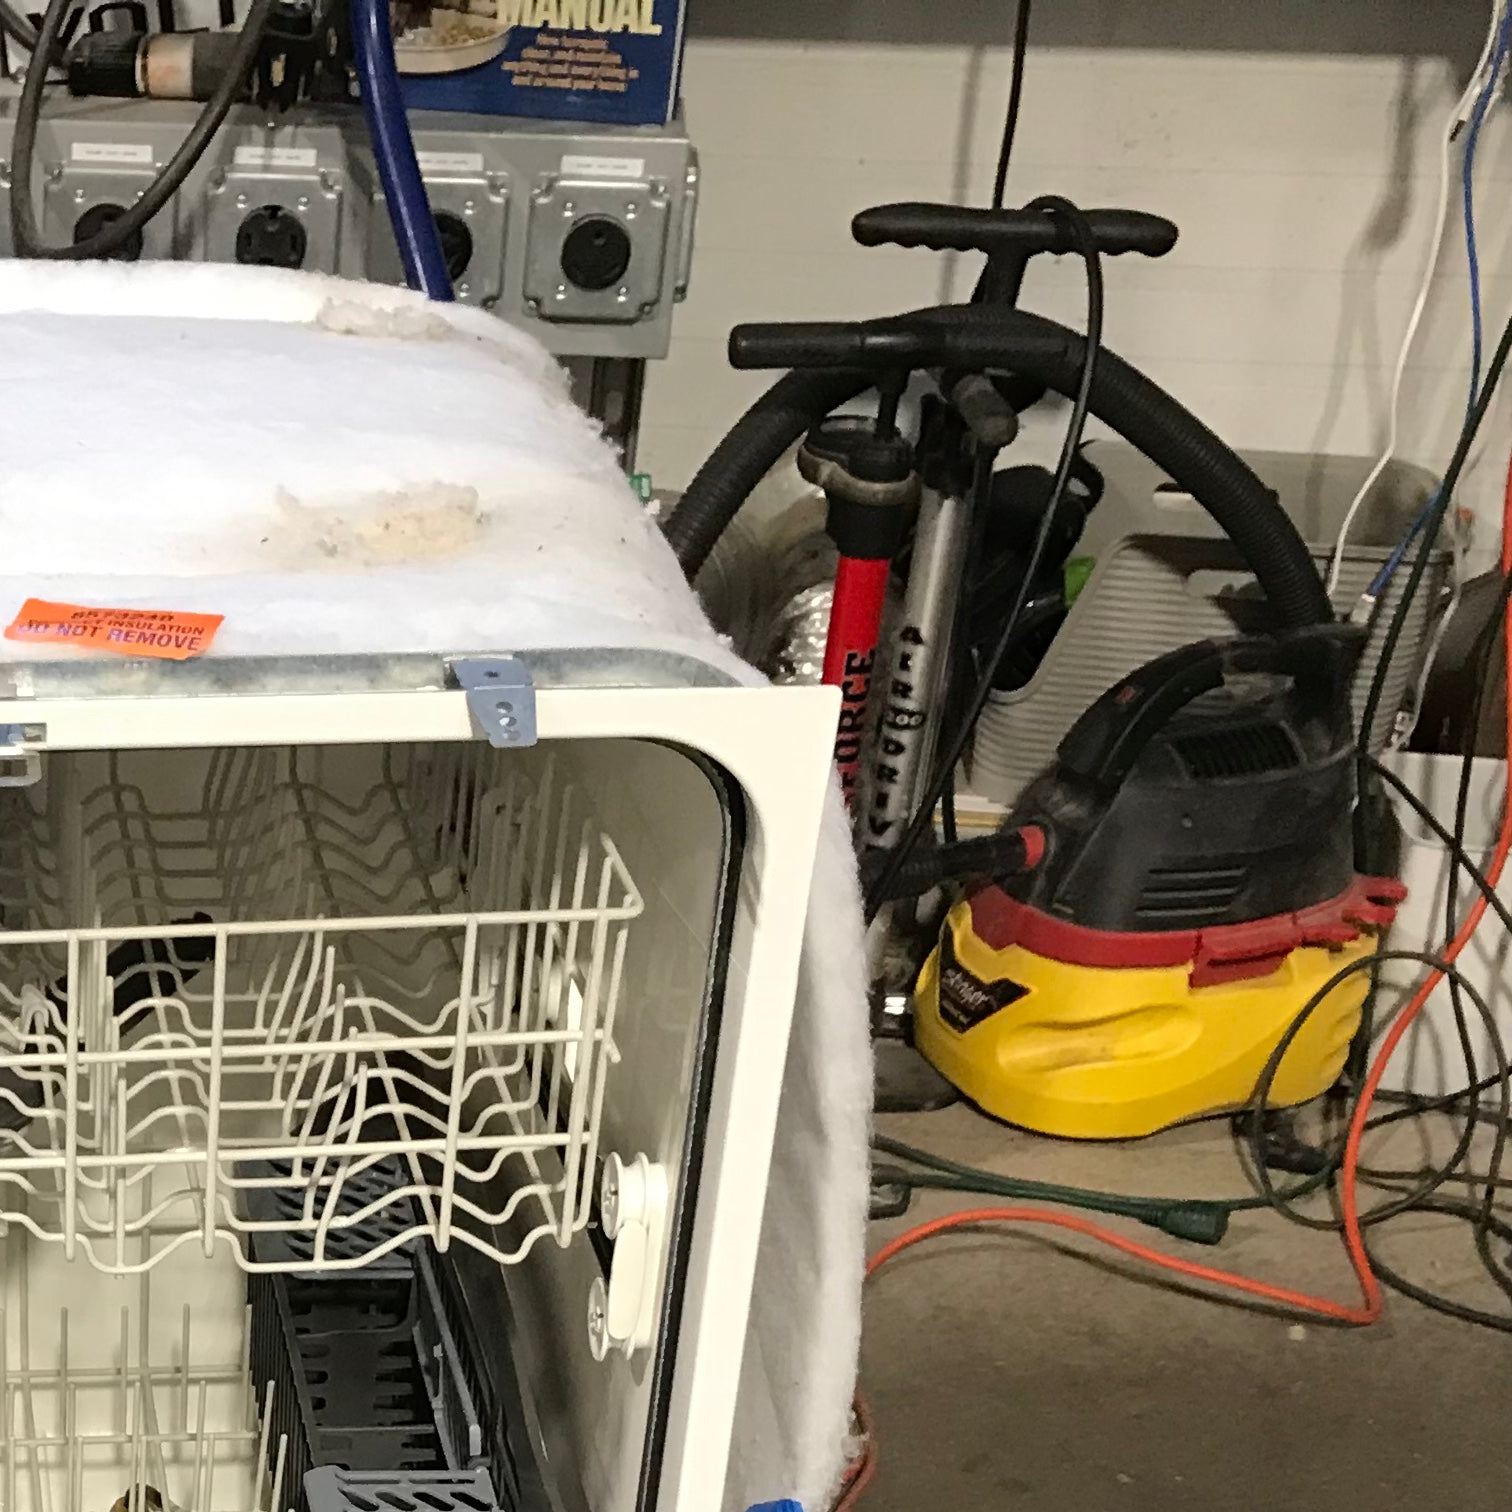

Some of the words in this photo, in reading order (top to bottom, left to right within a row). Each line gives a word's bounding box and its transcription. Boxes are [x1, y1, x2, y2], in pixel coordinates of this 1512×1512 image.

[57, 623, 103, 637] NOT
[108, 628, 202, 651] REMOVE
[108, 620, 204, 636] INSULATION
